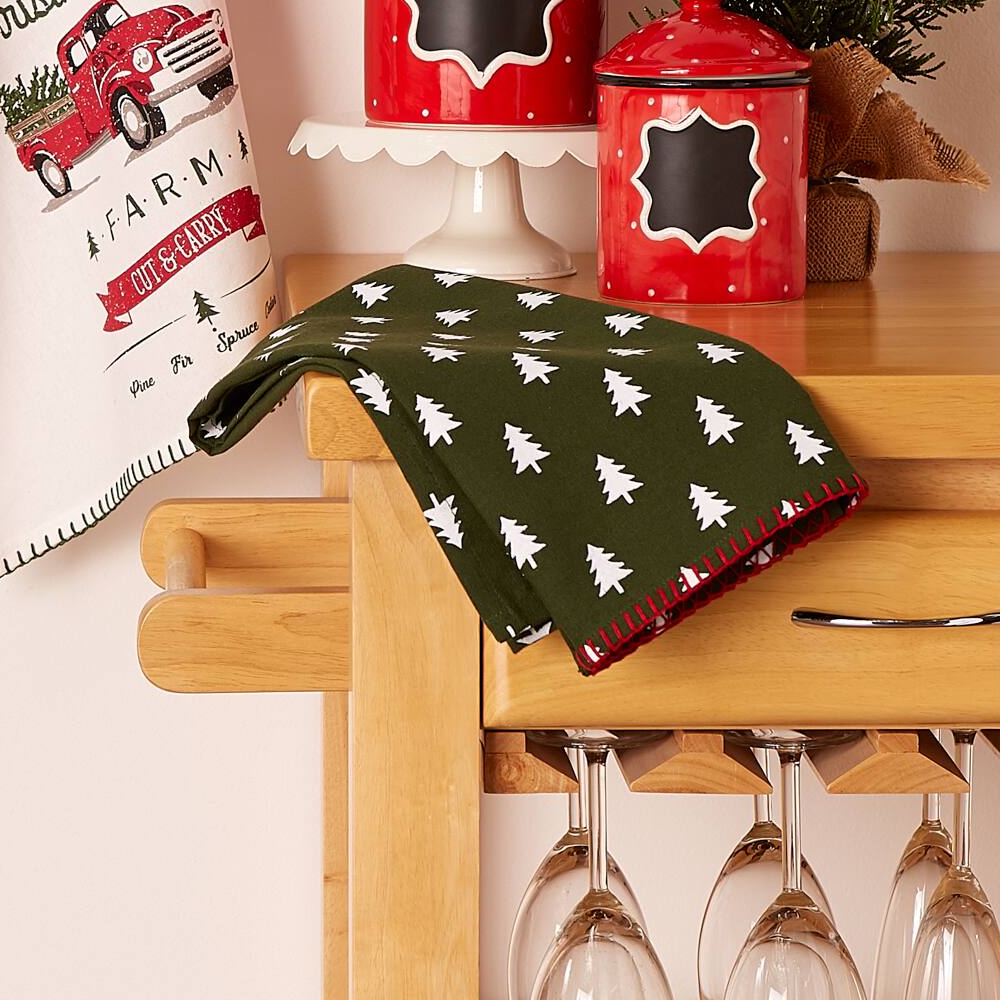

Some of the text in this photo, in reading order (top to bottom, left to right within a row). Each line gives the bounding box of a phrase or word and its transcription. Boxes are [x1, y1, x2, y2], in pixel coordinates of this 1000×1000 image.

[130, 203, 232, 296] CUT & CARRY
[129, 321, 260, 398] Pine Fir Spruce
